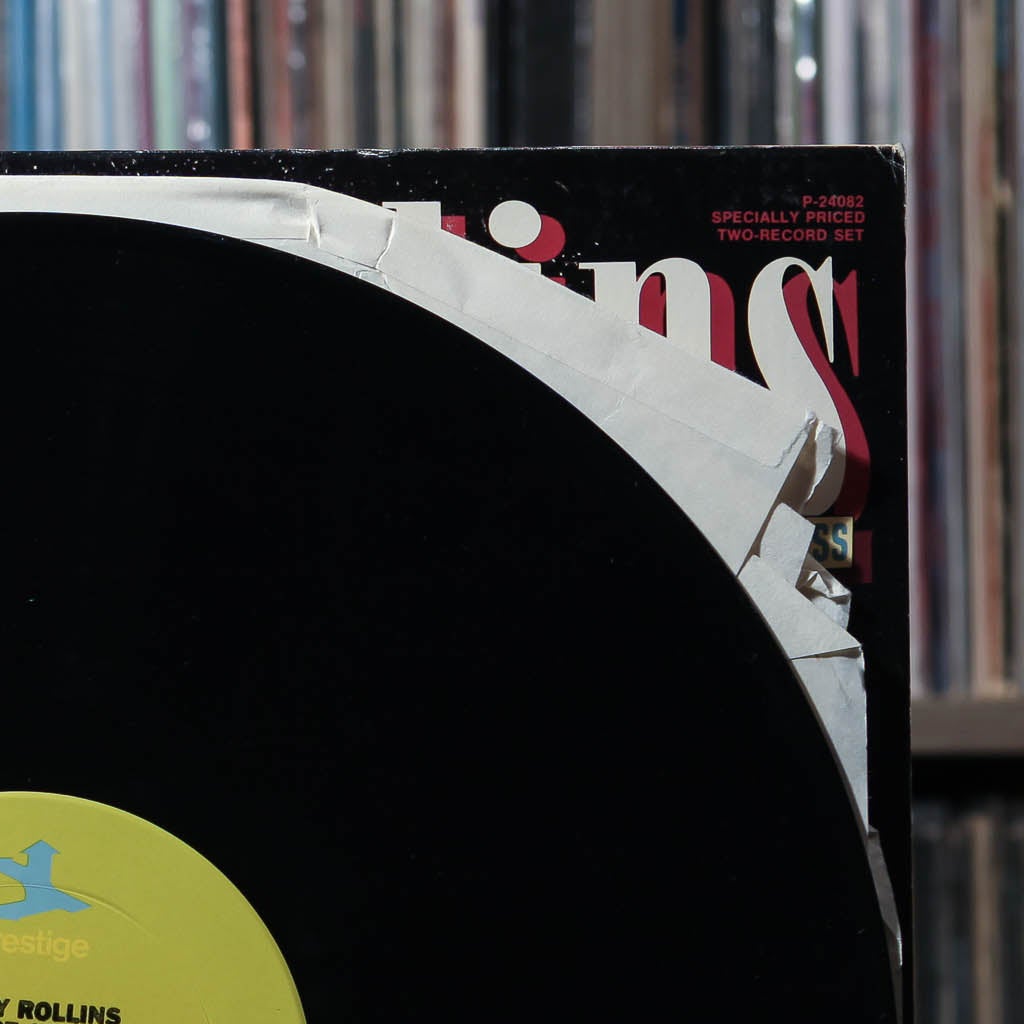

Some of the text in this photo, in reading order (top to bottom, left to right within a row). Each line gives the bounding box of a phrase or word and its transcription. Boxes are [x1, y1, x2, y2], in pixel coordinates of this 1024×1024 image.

[802, 195, 864, 208] P-24082
[711, 211, 865, 224] SPECIALLY PRICED
[717, 228, 865, 242] TWO-RECORD SET
